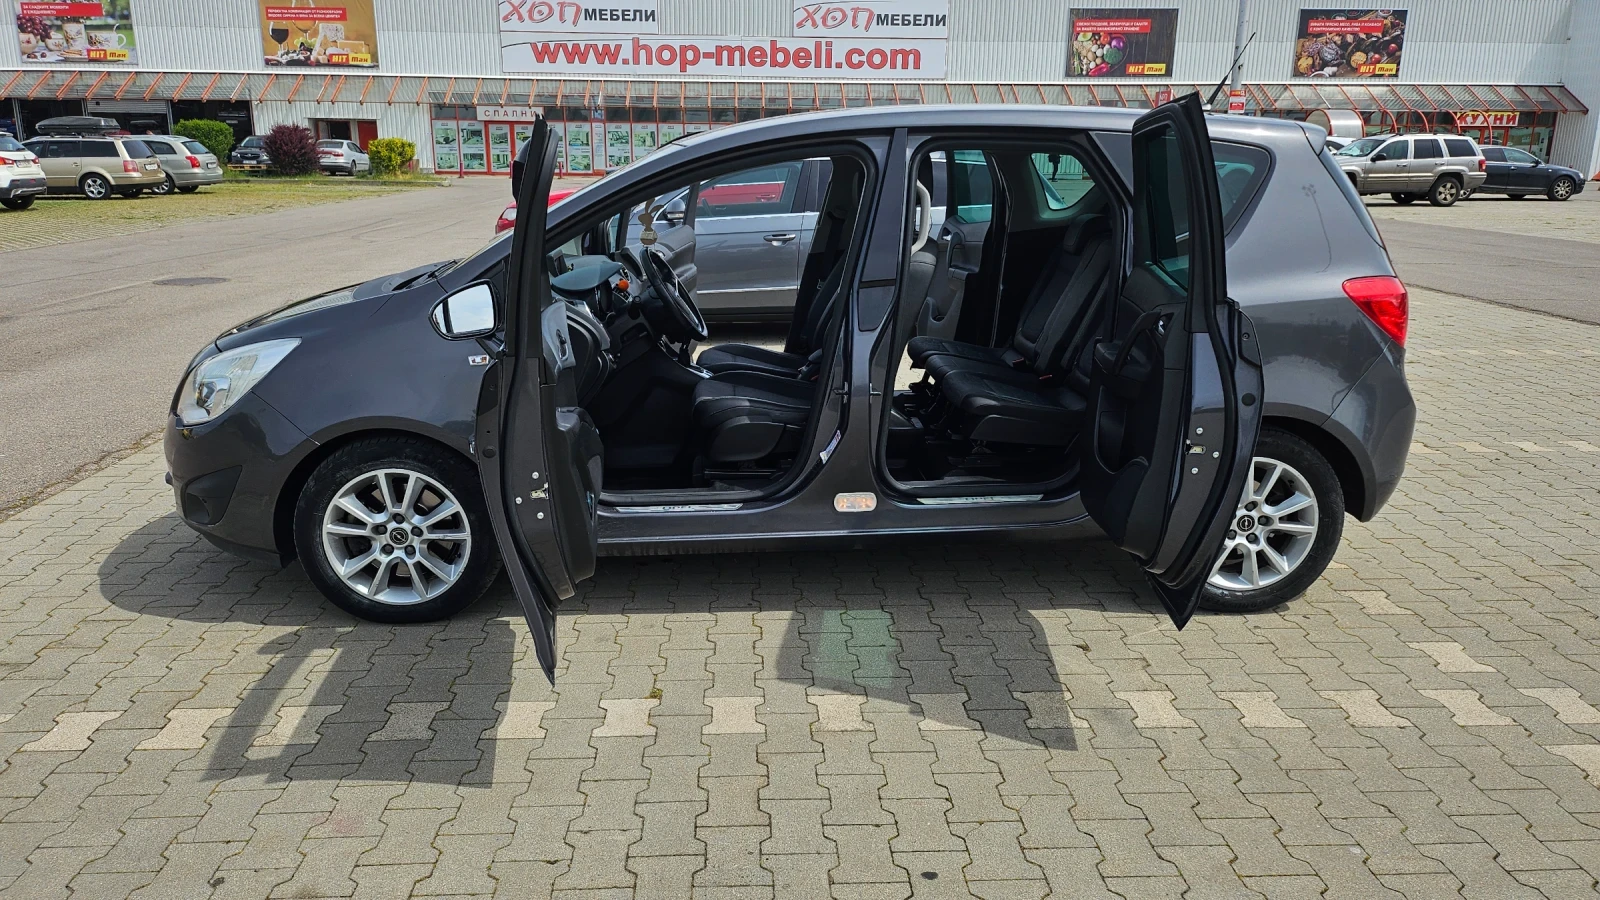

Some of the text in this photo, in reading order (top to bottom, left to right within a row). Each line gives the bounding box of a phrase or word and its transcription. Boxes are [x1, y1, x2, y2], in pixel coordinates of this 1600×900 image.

[502, 0, 656, 27] ХОП МЕБЕЛИ
[796, 5, 947, 32] ХОП МЕБЕЛИ
[90, 50, 105, 58] HIT
[332, 55, 348, 63] HIT
[530, 37, 921, 72] www.hop-mebeli.com
[1360, 65, 1375, 73] HIT
[484, 109, 537, 118] СПАЛНИ
[1459, 113, 1517, 125] КУХНИ
